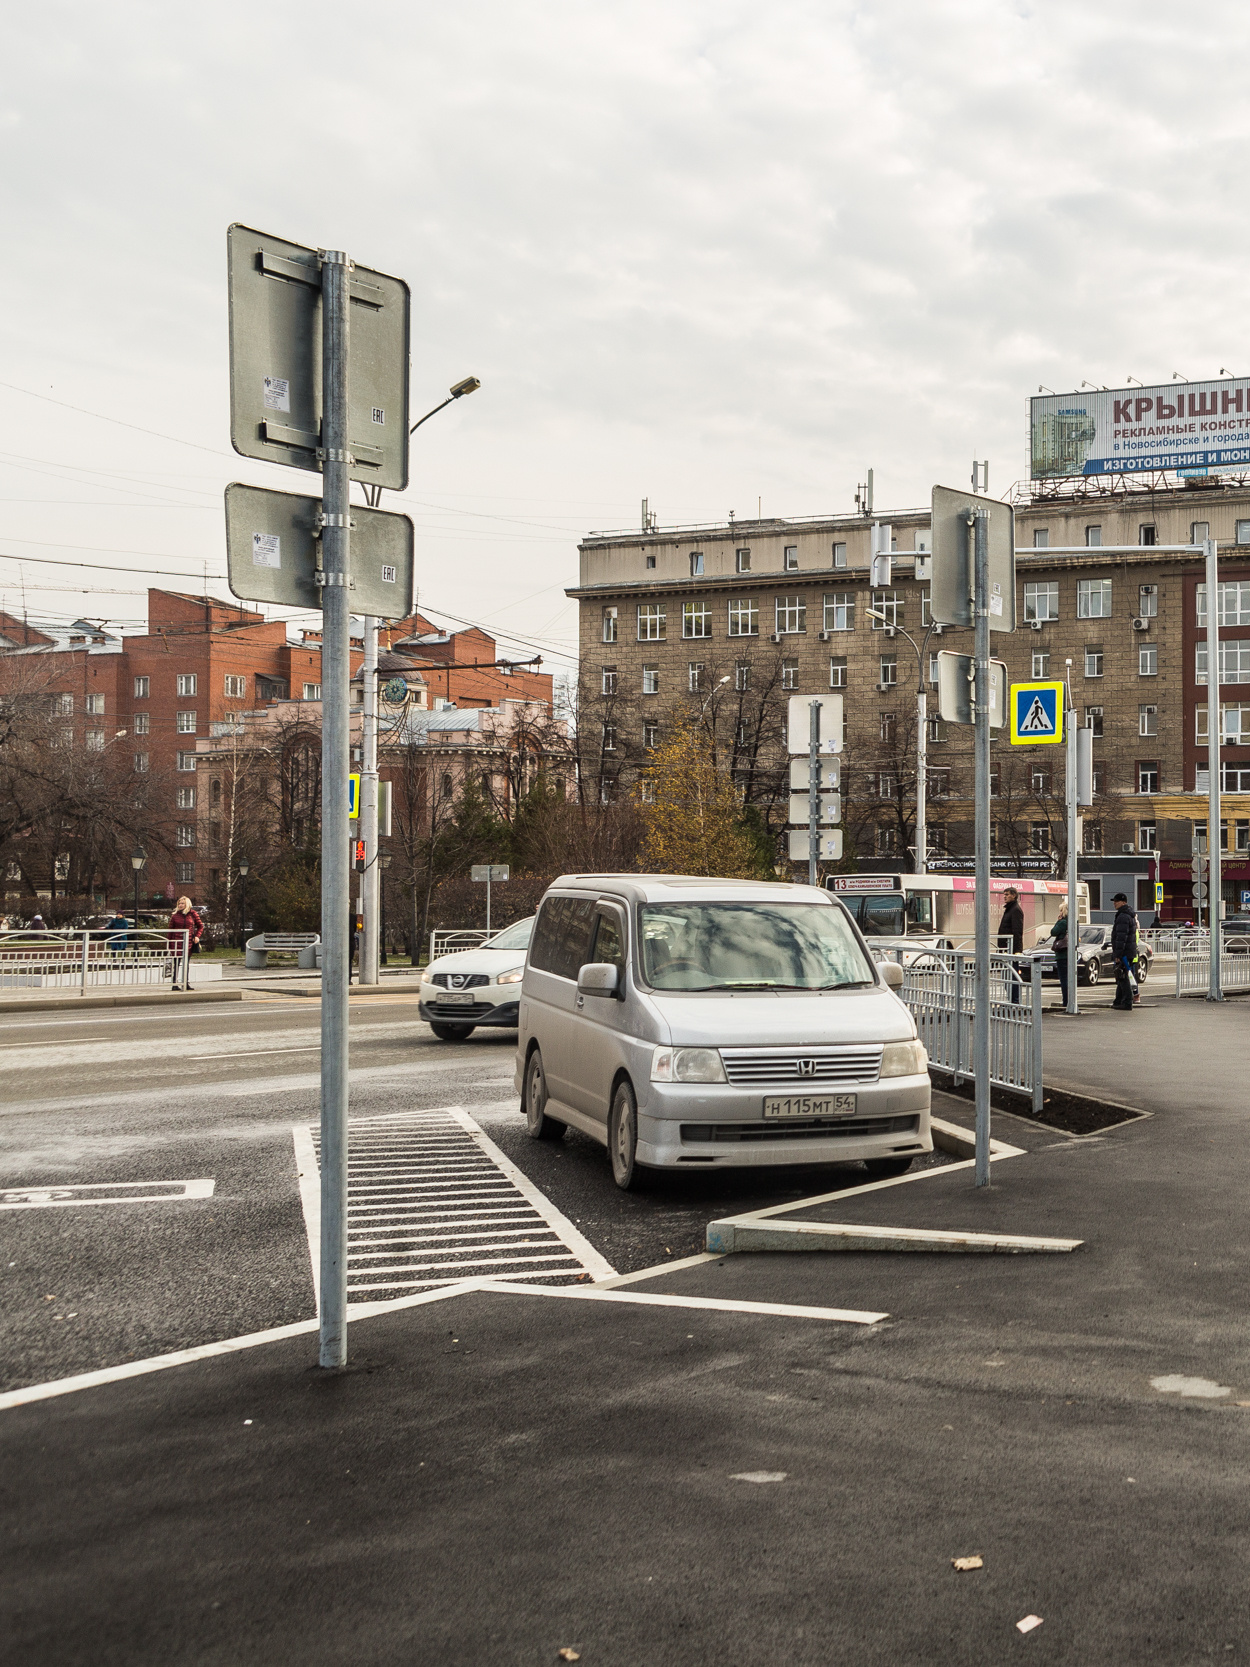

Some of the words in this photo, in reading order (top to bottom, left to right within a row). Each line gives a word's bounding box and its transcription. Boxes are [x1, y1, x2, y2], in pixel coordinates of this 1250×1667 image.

[1114, 423, 1196, 438] РЕКЛАМНЫЕ
[1123, 433, 1200, 450] Новосибирске
[1103, 453, 1204, 471] ИЗГОТОВЛЕНИЕ
[1207, 452, 1217, 463] И
[1228, 862, 1247, 870] центр
[835, 879, 847, 890] 13
[771, 1098, 832, 1114] Н115МТ
[835, 1096, 851, 1108] 54
